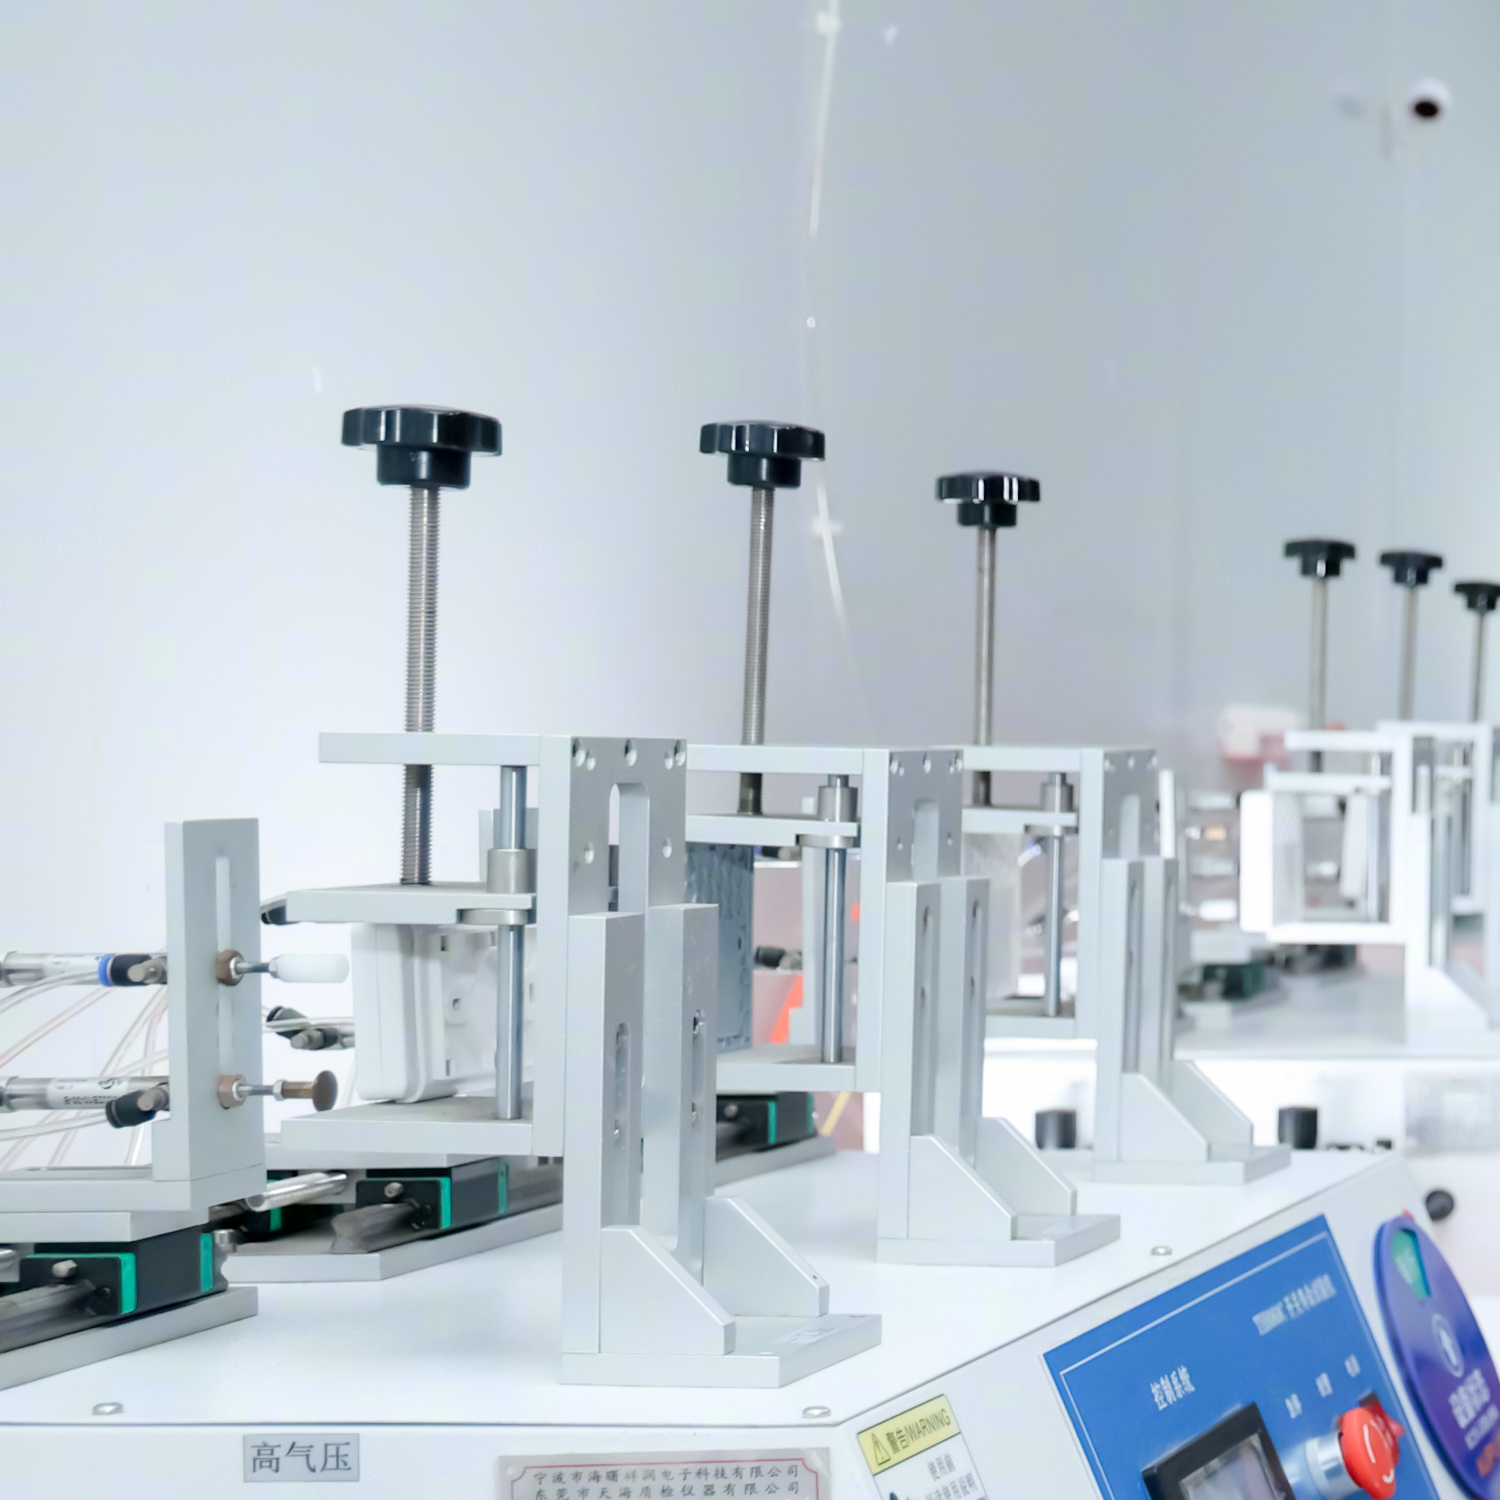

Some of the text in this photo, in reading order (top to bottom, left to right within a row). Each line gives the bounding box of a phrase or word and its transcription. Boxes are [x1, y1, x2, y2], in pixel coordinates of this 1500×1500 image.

[1150, 1365, 1195, 1411] 控制系统
[886, 1407, 952, 1453] 警告/WARNING
[250, 1441, 352, 1473] 高气压
